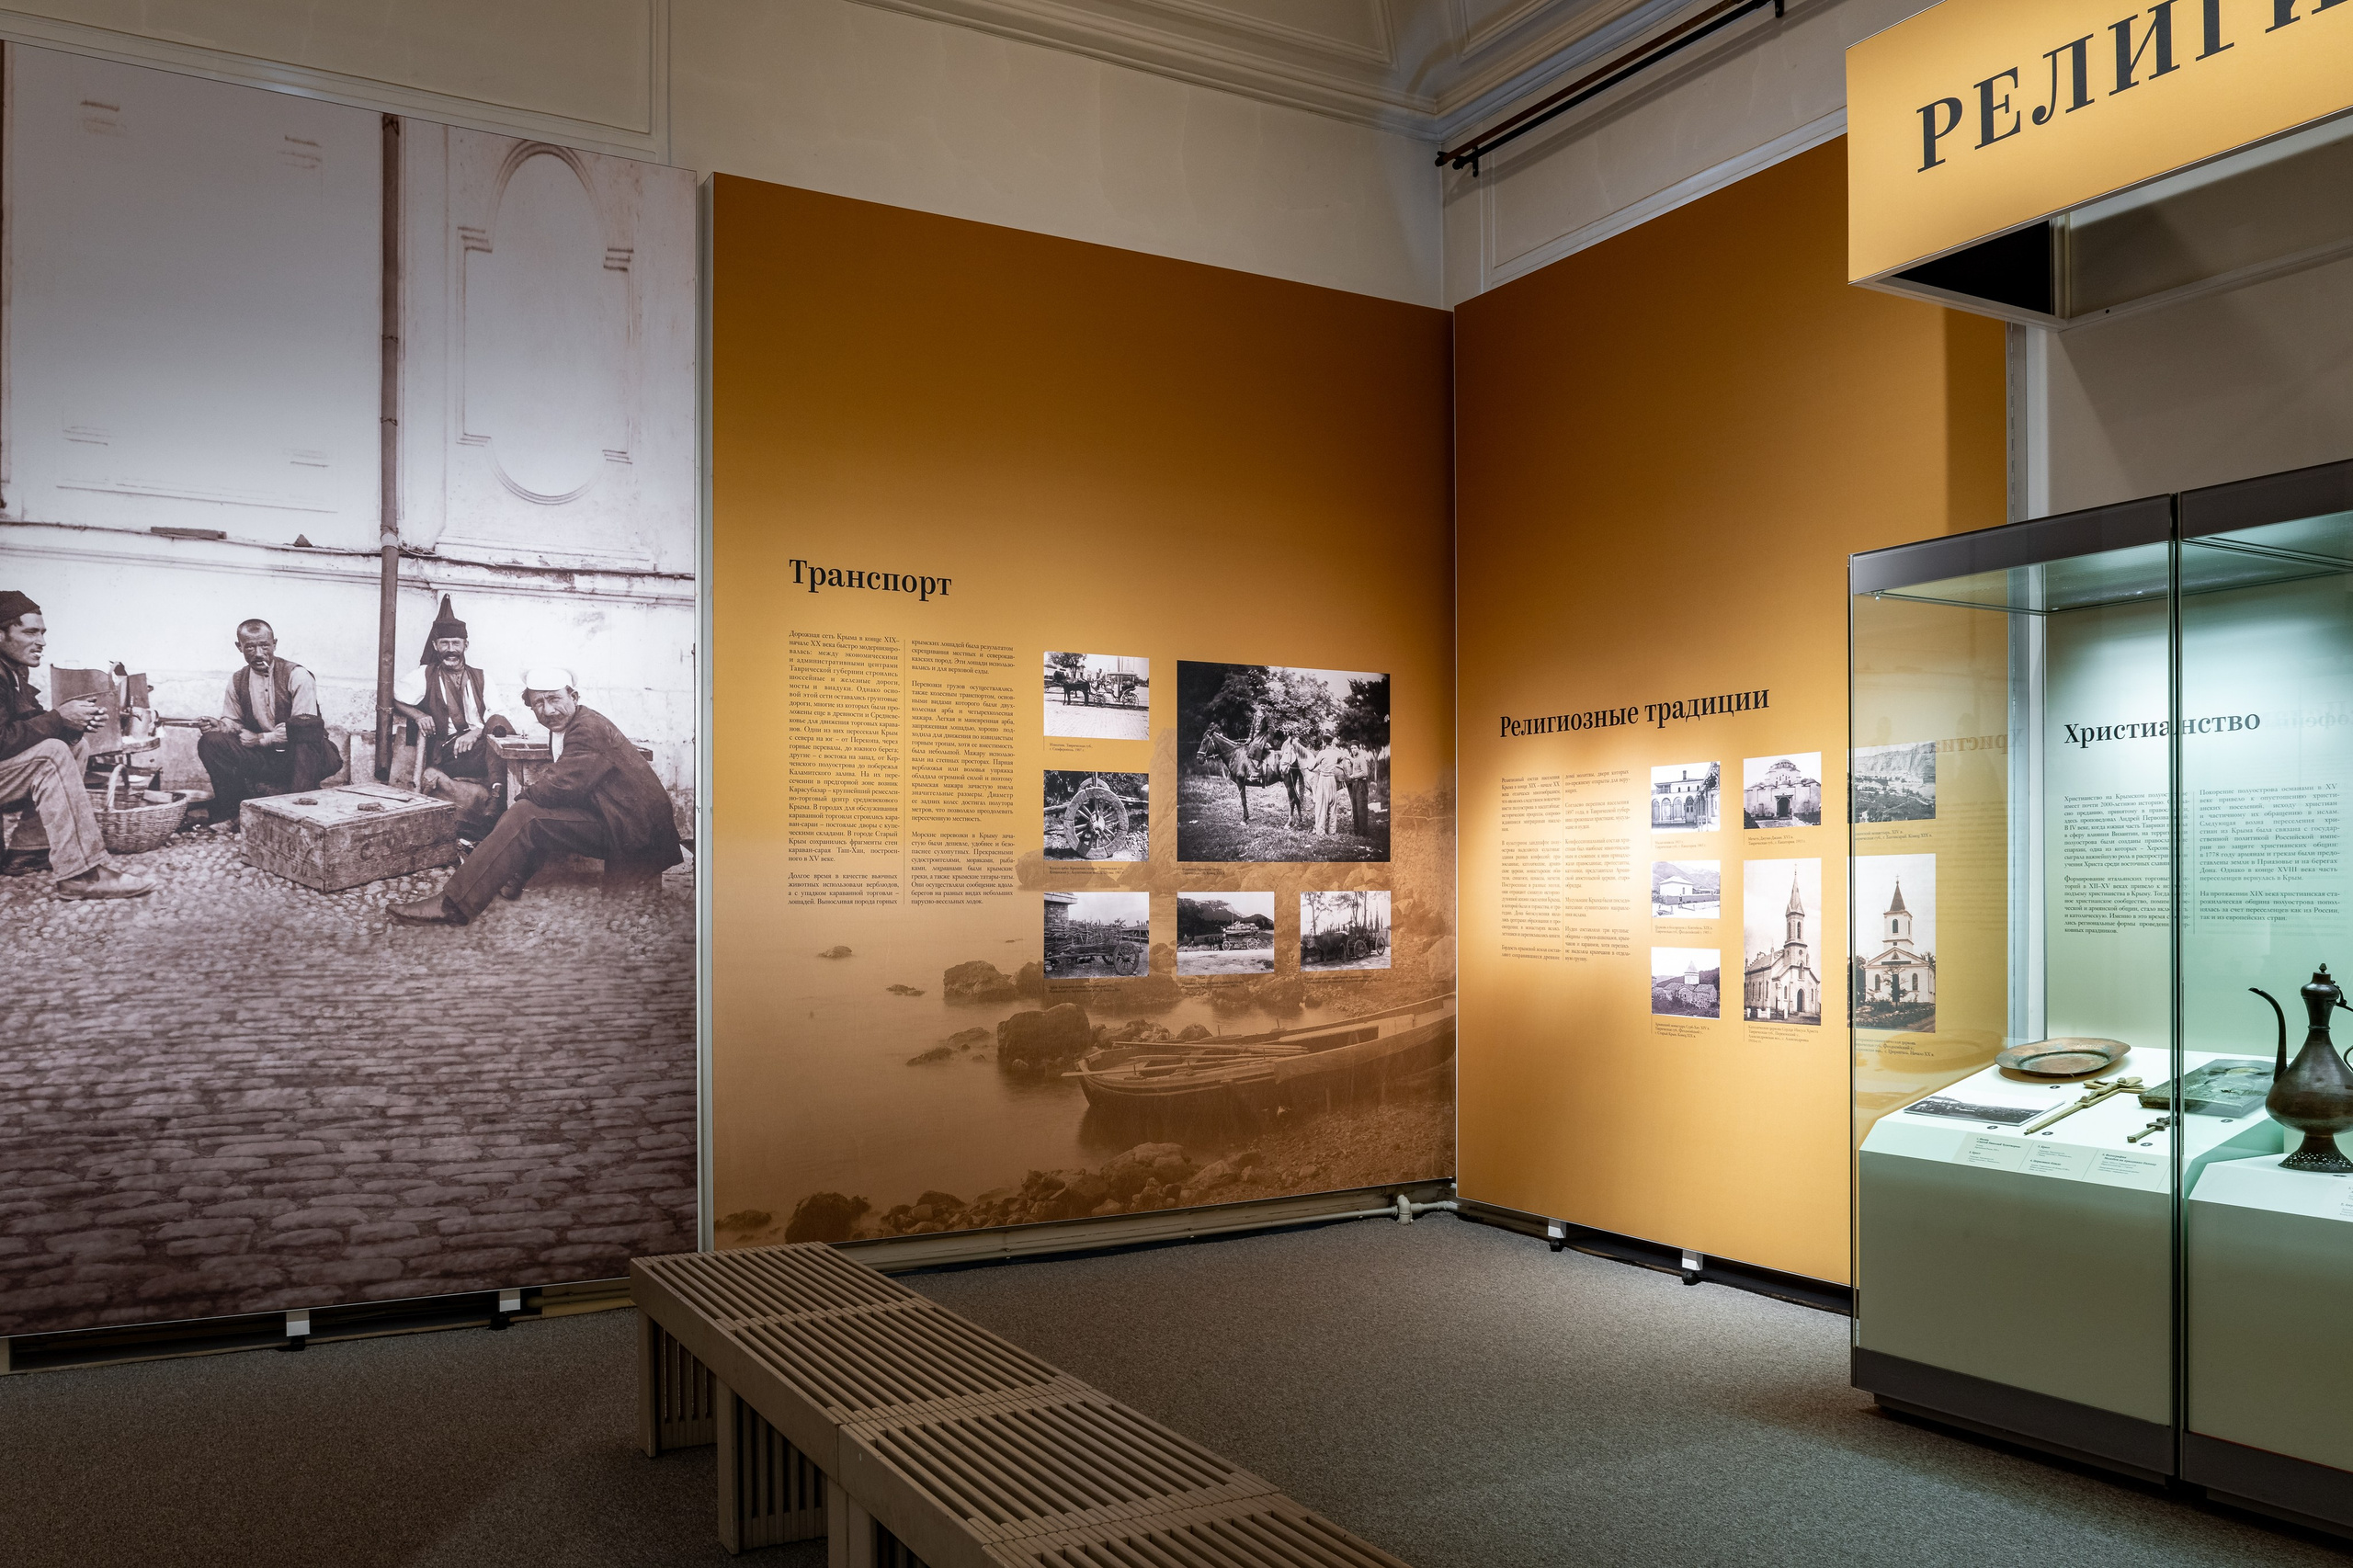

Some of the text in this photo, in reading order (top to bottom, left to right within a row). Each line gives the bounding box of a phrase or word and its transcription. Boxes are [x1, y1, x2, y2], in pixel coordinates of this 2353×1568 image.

[790, 559, 951, 602] Транспорт
[789, 630, 820, 639] Дорожная
[837, 633, 857, 642] Крыма
[836, 642, 858, 650] быстро
[859, 644, 900, 653] модернизиро-
[940, 640, 964, 649] лошадей
[797, 658, 864, 667] административными
[790, 665, 831, 674] Таврической
[834, 666, 863, 676] губернии
[949, 665, 973, 674] верховой
[790, 673, 825, 681] шоссейные
[912, 680, 942, 688] Перевозки
[857, 685, 881, 693] Однако
[1500, 688, 1770, 738] Религиозные традиции
[2200, 788, 2234, 796] Покорение
[2264, 809, 2302, 818] обращению
